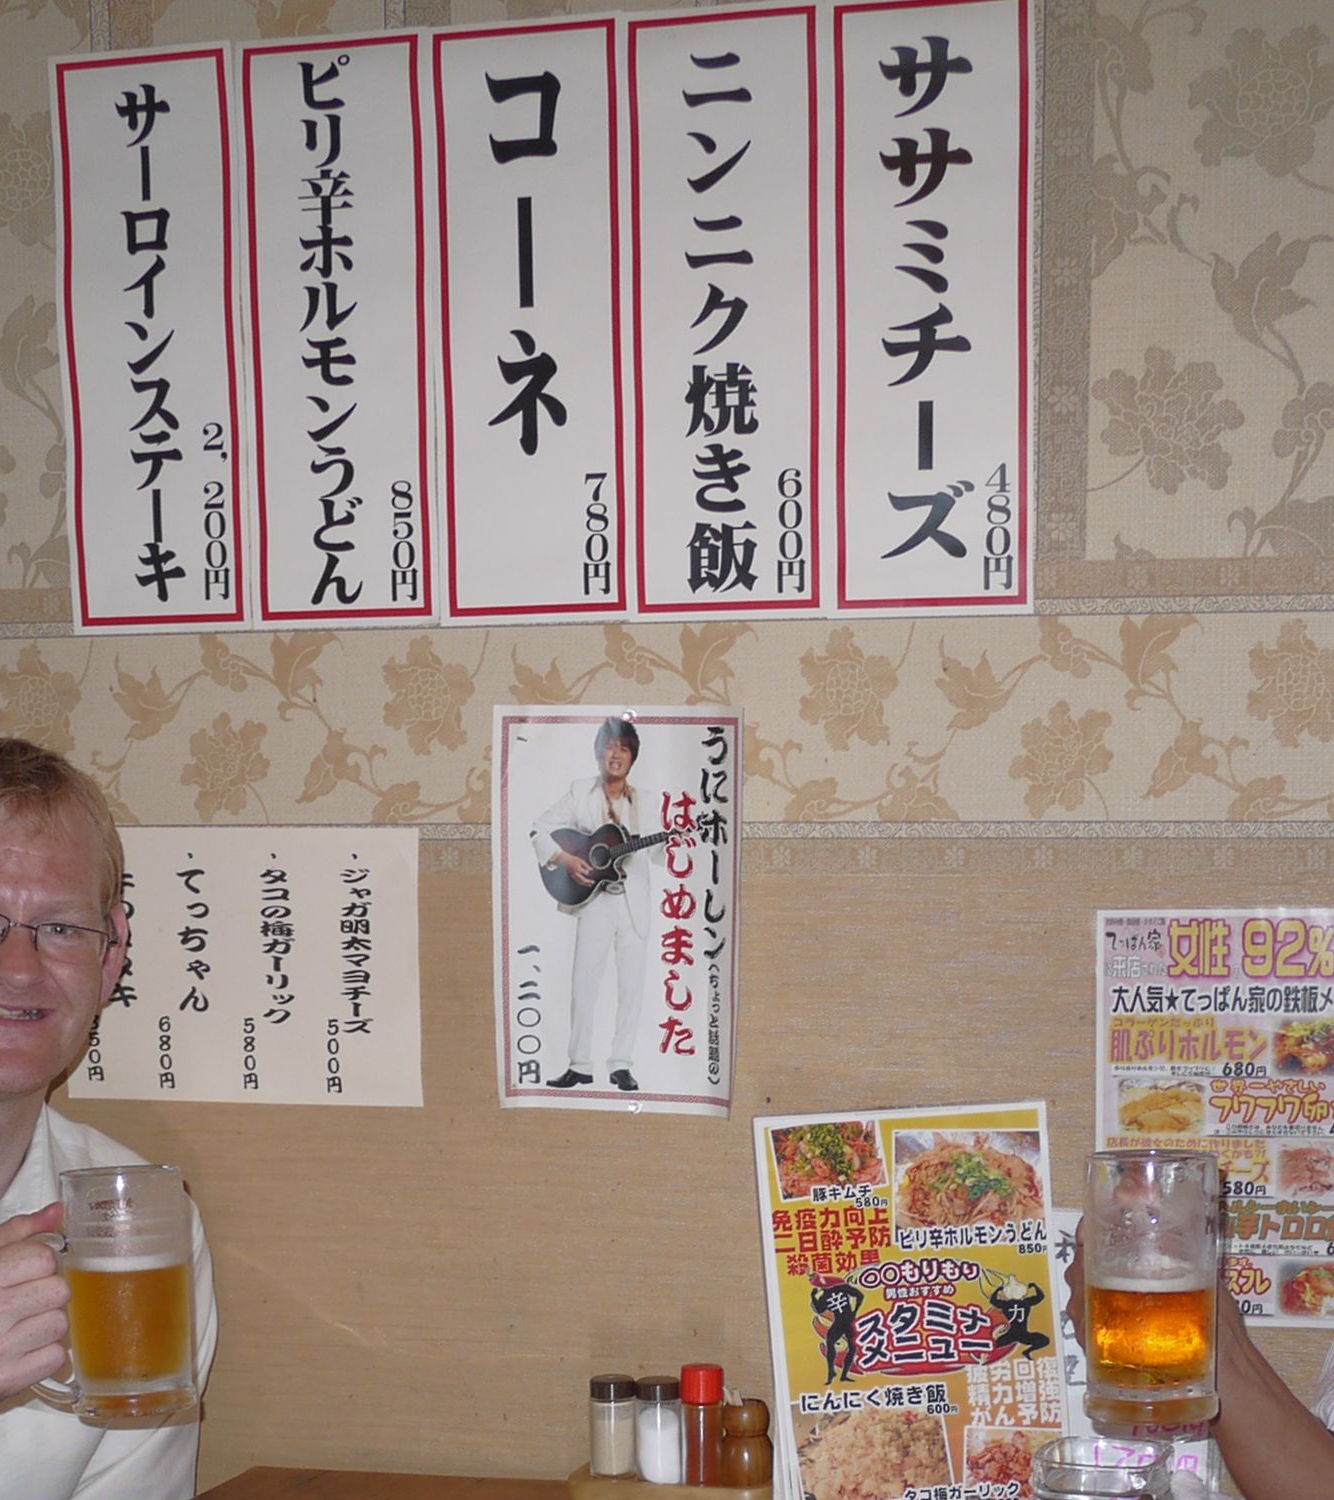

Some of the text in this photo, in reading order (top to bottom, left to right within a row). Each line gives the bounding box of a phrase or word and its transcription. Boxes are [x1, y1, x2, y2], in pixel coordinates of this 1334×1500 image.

[484, 70, 568, 456] コーネ
[878, 35, 975, 560] ササミチーズ
[115, 83, 186, 603] サーロインステーキ
[297, 54, 364, 605] ピリ辛ホルモンうどん
[682, 51, 759, 594] ニンニク焼き飯
[390, 480, 418, 602] 850円
[583, 472, 612, 596] 780円
[776, 467, 807, 594] 600円
[982, 462, 1014, 591] 480円
[176, 868, 211, 1013] てっちゃん
[259, 868, 296, 1025] タコの梅ガーリック
[339, 868, 374, 1035] ジャガ明太マヨチーズ
[658, 790, 697, 1057] はじめました
[1168, 918, 1230, 978] 女性
[158, 1015, 176, 1089] 680円
[243, 1017, 259, 1091] 580円
[326, 1018, 343, 1094] 500円
[1109, 1026, 1268, 1062] 肌ぷりホルモン
[1221, 1061, 1267, 1078] 680円
[771, 1206, 890, 1232] 免疫力向上
[812, 1184, 872, 1202] 豚キムチ
[855, 1196, 888, 1209] 580円
[773, 1226, 892, 1254] 二日酔予防
[899, 1220, 1047, 1250] ピリ辛ホルモンうどん
[857, 1300, 992, 1345] スタミナ
[885, 1285, 955, 1300] 男性おすすめ
[1008, 1304, 1026, 1324] 力
[1239, 1299, 1264, 1314] 0円
[860, 1332, 994, 1367] メニュー
[801, 1383, 946, 1412] にんにく焼き飯
[926, 1403, 958, 1415] 600円
